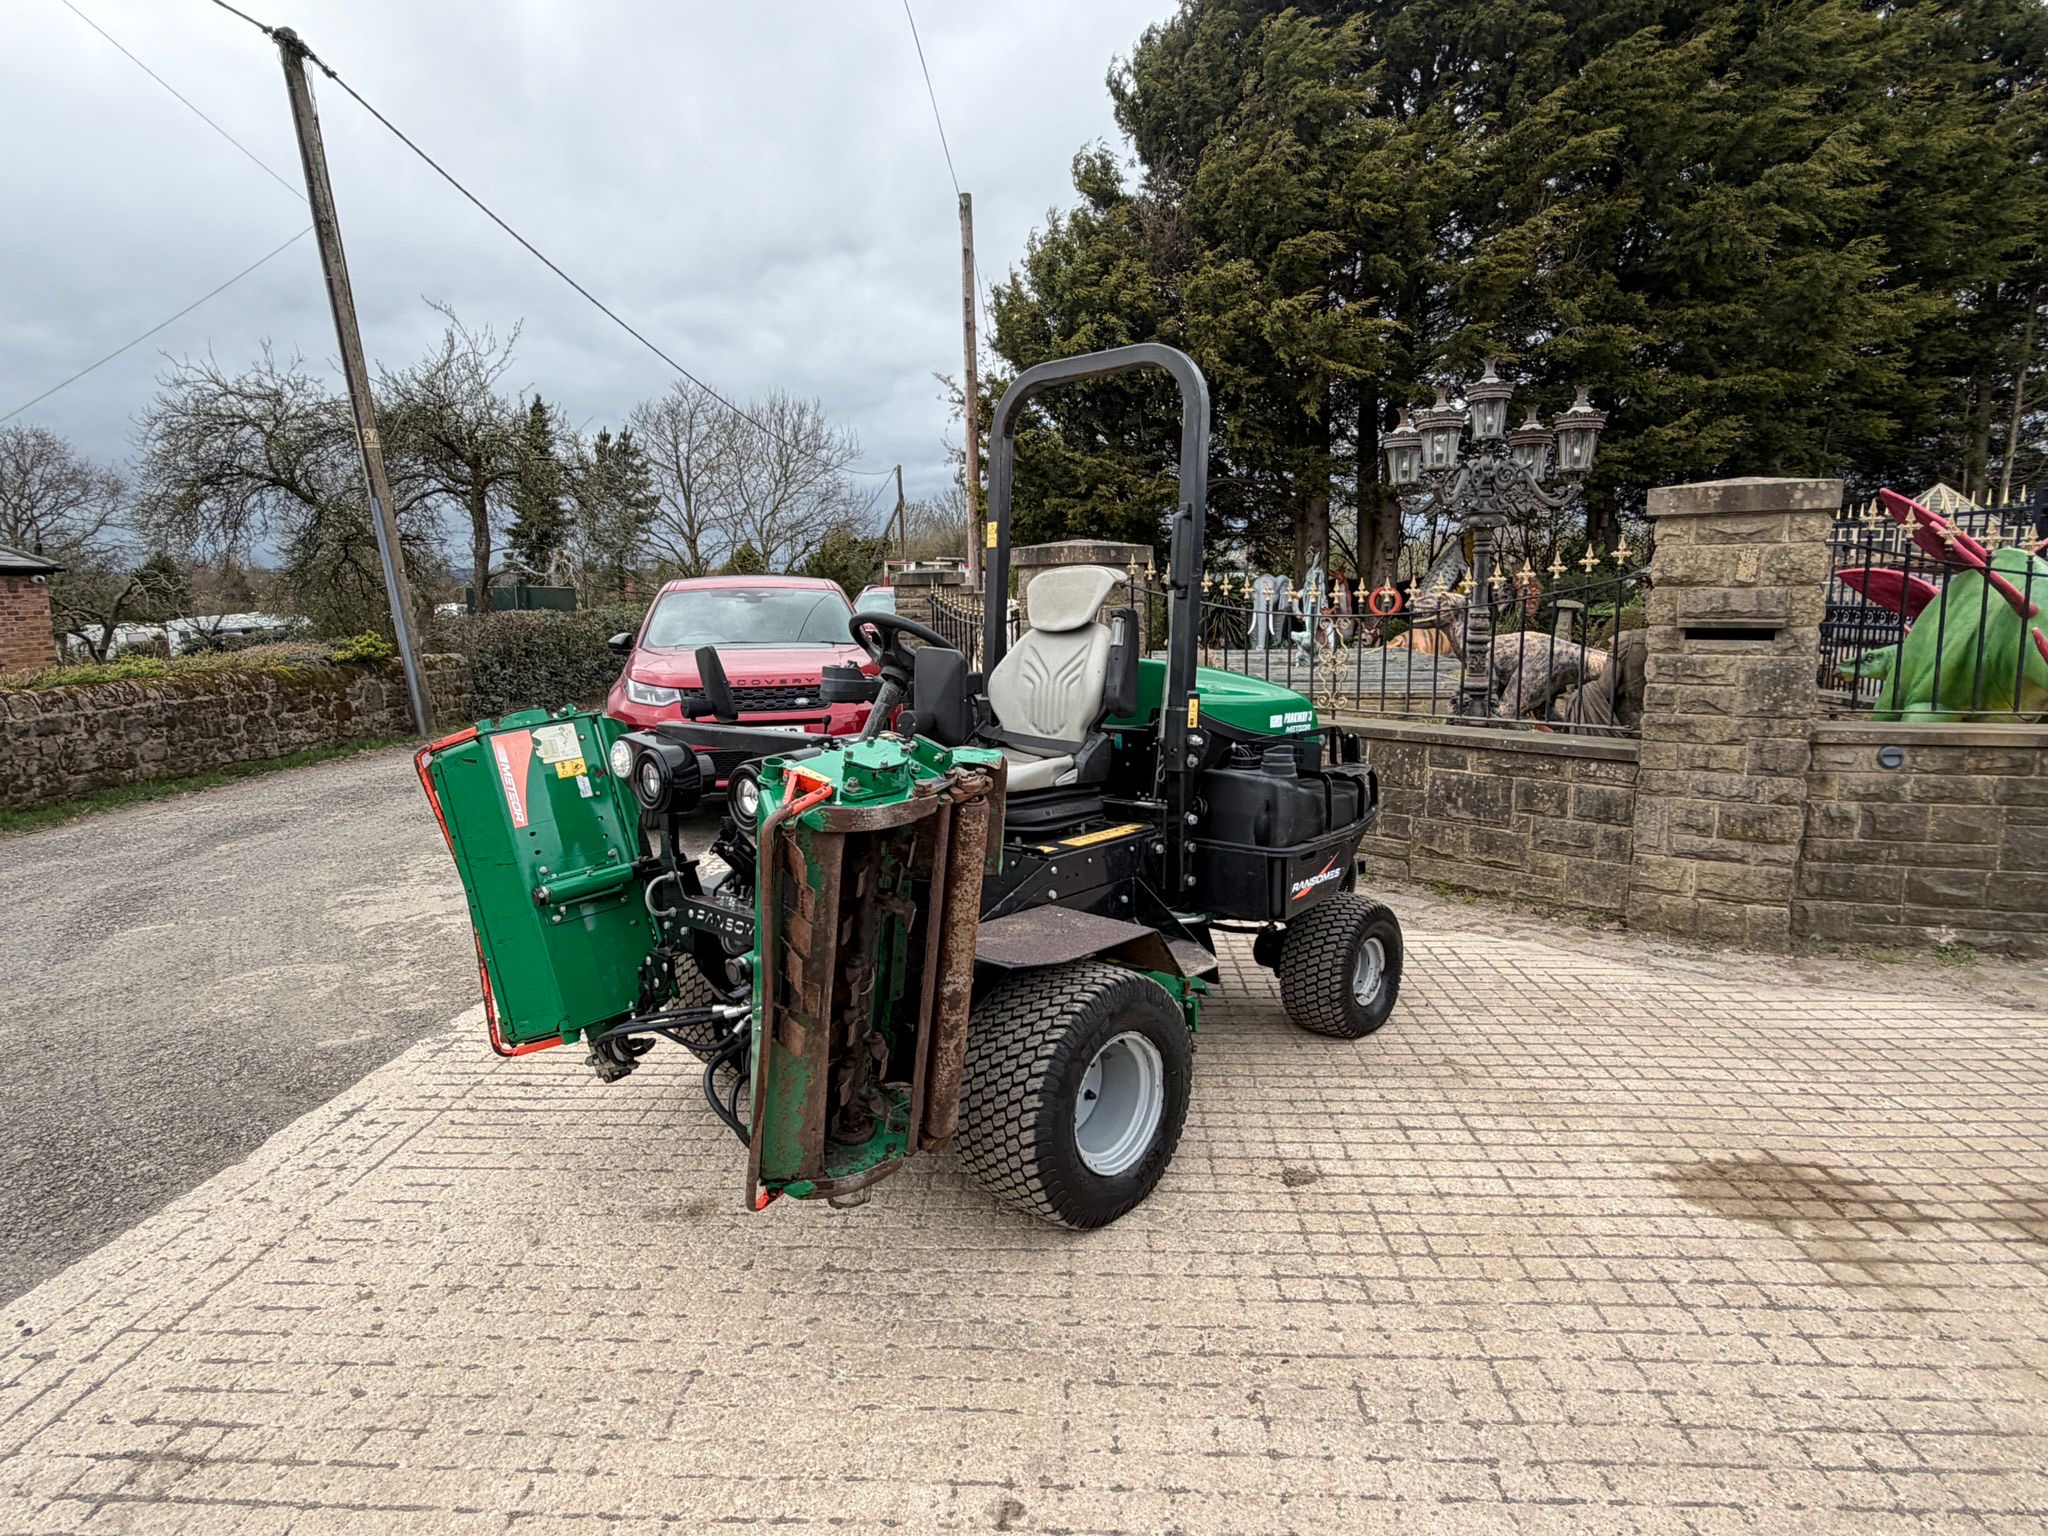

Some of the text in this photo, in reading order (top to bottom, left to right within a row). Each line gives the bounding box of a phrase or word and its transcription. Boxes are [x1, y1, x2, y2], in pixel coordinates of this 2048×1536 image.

[1284, 711, 1308, 723] PARKWAY
[1285, 724, 1311, 733] METEOR
[500, 762, 525, 822] METEOR
[1292, 867, 1341, 892] RANSOMES
[697, 909, 755, 936] RANSOM
